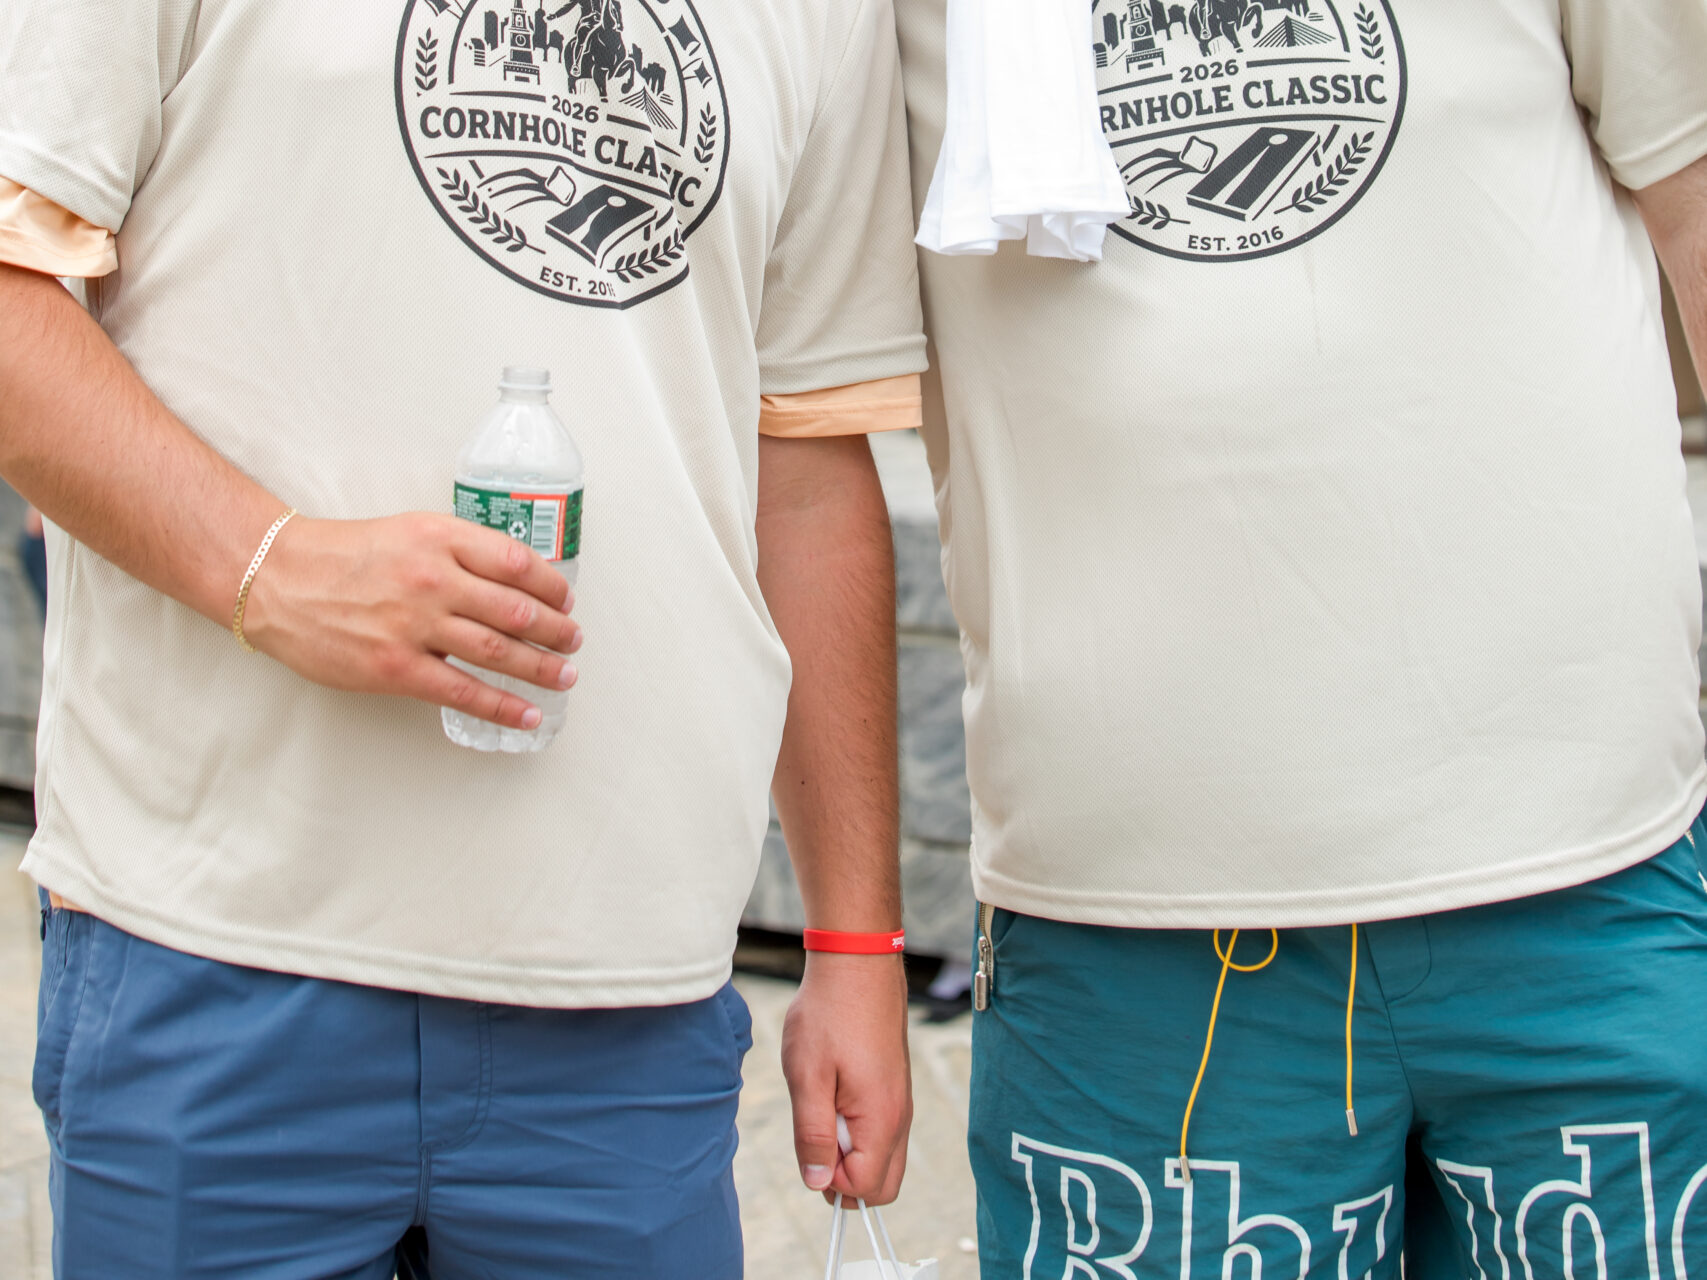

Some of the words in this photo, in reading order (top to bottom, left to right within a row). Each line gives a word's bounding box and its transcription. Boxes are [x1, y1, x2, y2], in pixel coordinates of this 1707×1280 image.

[1180, 59, 1239, 83] 2026
[552, 95, 599, 123] 2026
[1099, 84, 1235, 134] RNHOLE
[1242, 74, 1388, 108] CLASSIC
[420, 106, 587, 158] CORNHOLE
[1188, 234, 1231, 252] EST.
[1237, 225, 1284, 251] 2016
[540, 265, 582, 293] EST.
